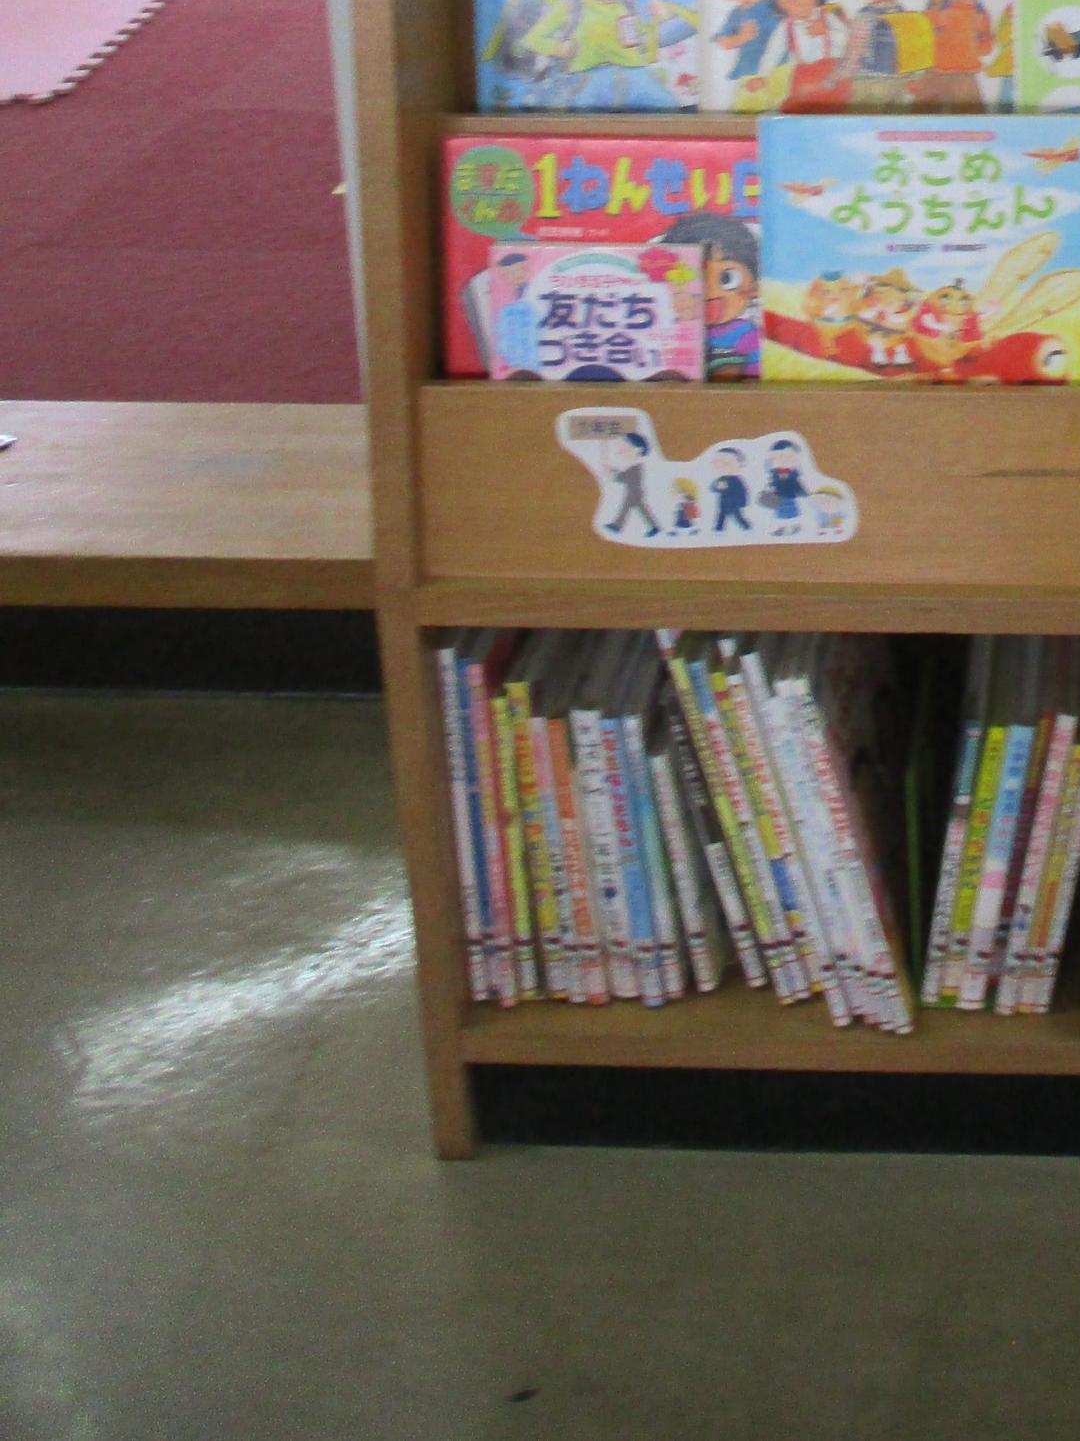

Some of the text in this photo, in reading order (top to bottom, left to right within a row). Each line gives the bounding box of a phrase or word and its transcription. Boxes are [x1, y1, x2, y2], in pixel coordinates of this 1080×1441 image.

[873, 146, 1003, 187] おこめ
[831, 184, 1057, 235] ようちえん
[537, 289, 656, 331] 友だち
